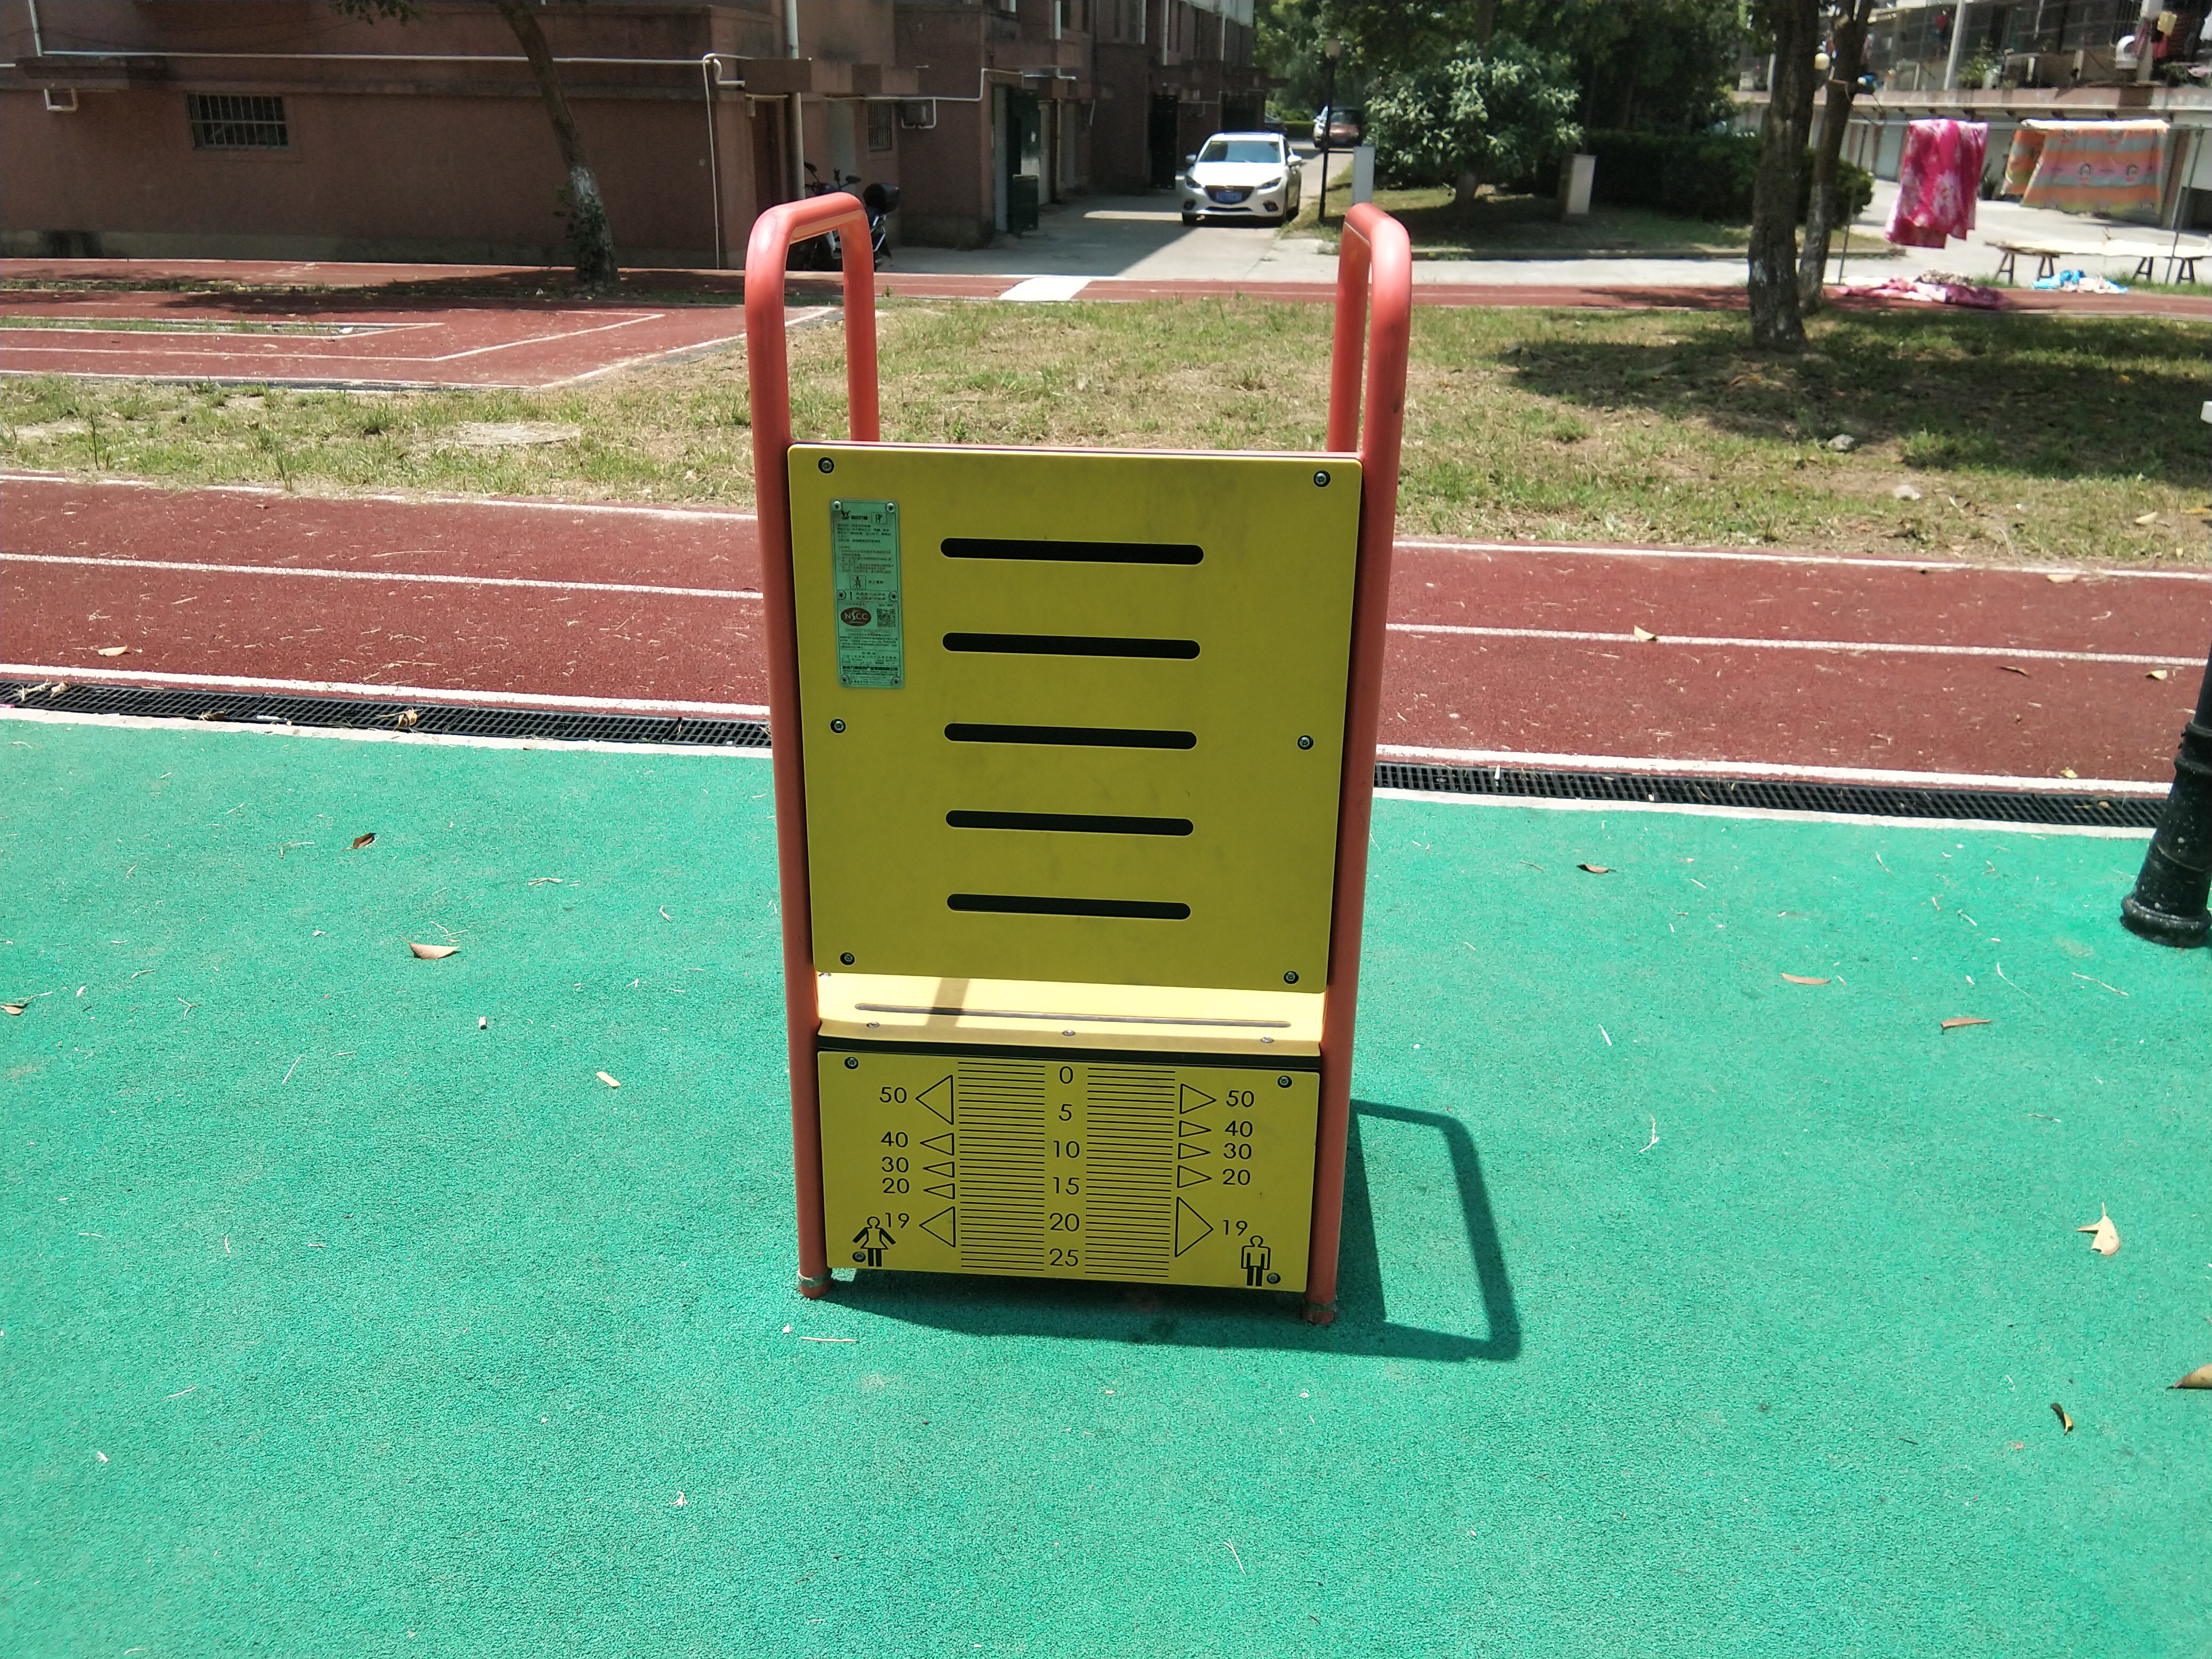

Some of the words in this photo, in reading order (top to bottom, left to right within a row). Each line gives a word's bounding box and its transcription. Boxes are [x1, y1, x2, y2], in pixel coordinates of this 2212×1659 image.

[844, 610, 868, 623] NSCC
[1060, 1066, 1073, 1084] 0
[879, 1087, 907, 1103] 50
[1226, 1090, 1254, 1108] 50
[1059, 1104, 1072, 1121] 5
[1225, 1120, 1253, 1137] 40
[881, 1132, 908, 1147] 40
[1053, 1141, 1079, 1158] 10
[1224, 1143, 1252, 1159] 30
[882, 1157, 908, 1172] 30
[1223, 1169, 1250, 1185] 20
[883, 1178, 909, 1193] 20
[1053, 1177, 1079, 1195] 15
[885, 1212, 909, 1228] 19
[1050, 1213, 1079, 1231] 20
[1224, 1220, 1247, 1236] 19
[1050, 1249, 1078, 1267] 25
